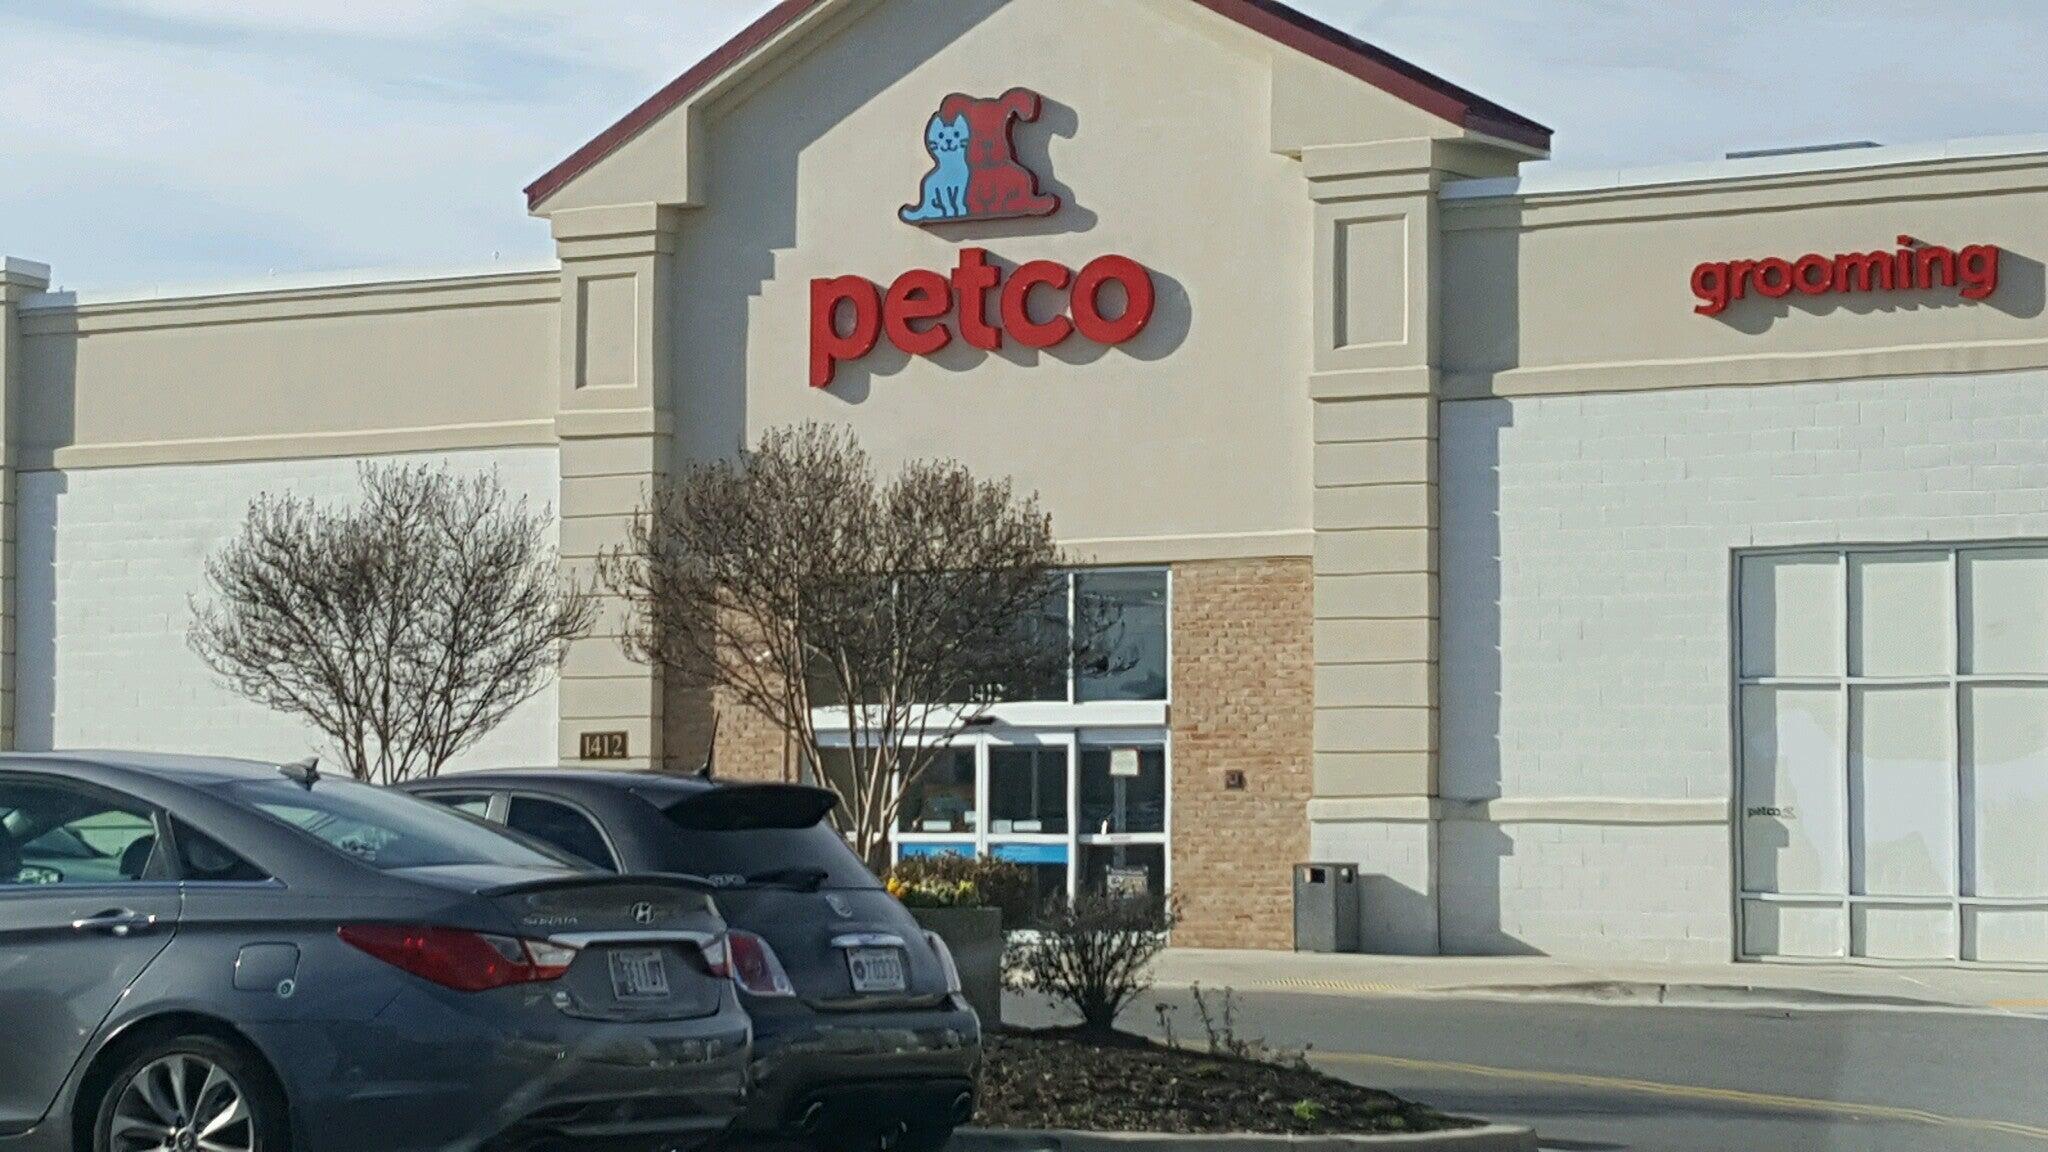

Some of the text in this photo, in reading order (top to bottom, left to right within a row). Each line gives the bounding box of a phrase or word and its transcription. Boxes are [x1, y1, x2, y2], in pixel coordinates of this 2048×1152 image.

[1690, 234, 1999, 316] grooming
[809, 247, 1155, 388] petco
[584, 734, 623, 756] 1412
[1747, 806, 1781, 818] petco
